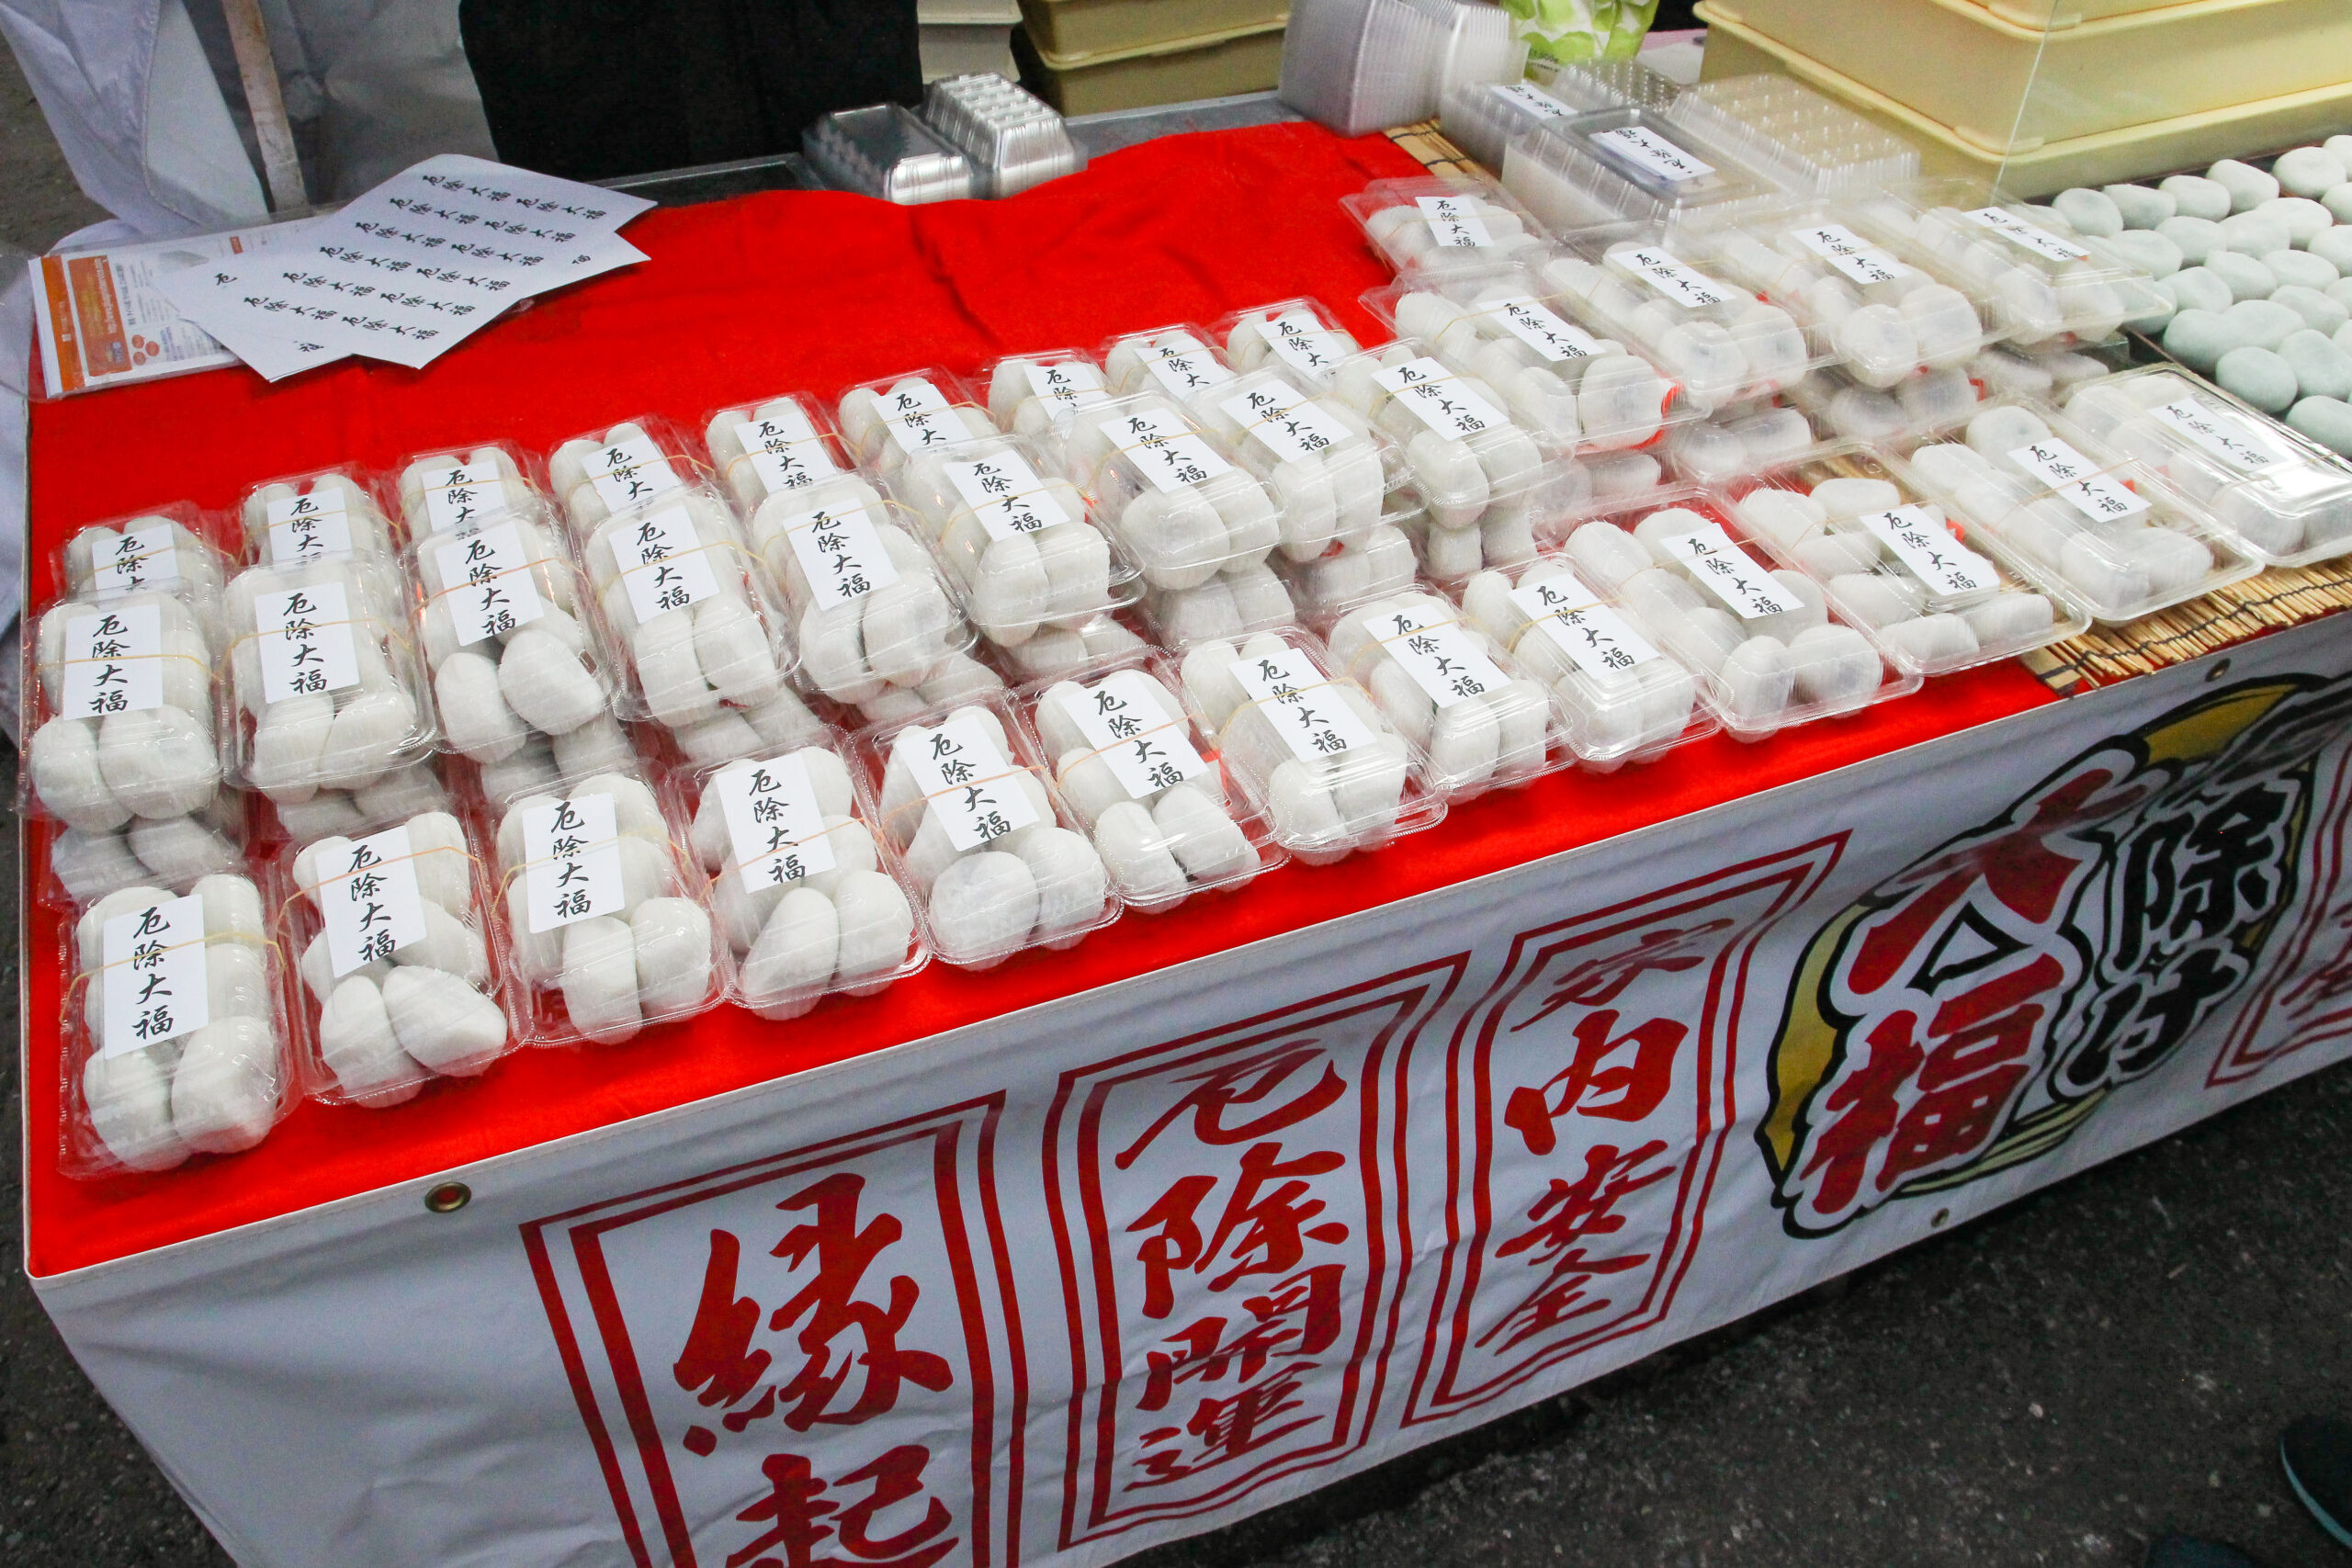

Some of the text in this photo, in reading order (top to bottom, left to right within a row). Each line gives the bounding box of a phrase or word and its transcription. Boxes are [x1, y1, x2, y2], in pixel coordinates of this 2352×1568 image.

[390, 197, 576, 243] 厄除大福 厄除大福
[423, 175, 607, 220] 厄除大福 厄除大福
[1436, 198, 1476, 248] 厄除大福
[320, 246, 511, 292] 厄除大福 厄除大福
[356, 221, 544, 267] 厄除大福 厄除大福
[1817, 230, 1894, 282] 厄除大福
[283, 272, 476, 316] 厄除大福 厄除大福
[1634, 253, 1721, 306] 厄除大福
[243, 297, 439, 341] 厄除大福 厄除大福
[1278, 321, 1336, 381] 厄除大
[1503, 302, 1589, 359] 厄除大福
[1046, 368, 1082, 418] 厄除
[1159, 346, 1211, 388] 厄除大
[1398, 367, 1486, 432] 厄除大福
[896, 392, 947, 446] 厄除大
[1127, 417, 1208, 484] 厄除大福
[1247, 391, 1330, 452] 厄除大福
[2166, 405, 2269, 464] 厄除大福
[606, 447, 653, 502] 厄除大
[974, 463, 1043, 532] 厄除大福
[2029, 445, 2128, 515] 厄除大福
[115, 536, 149, 592] 厄除大
[289, 498, 323, 565] 厄除大
[811, 512, 871, 598] 厄除大福
[1883, 513, 1977, 590] 厄除大福
[465, 538, 516, 637] 厄除大福
[637, 521, 690, 611] 厄除大福
[1689, 538, 1784, 615] 厄除大福
[282, 592, 328, 693] 厄除大福
[1394, 615, 1486, 698] 厄除大福
[1538, 585, 1635, 671] 厄除大福
[89, 617, 130, 713] 厄除大福
[1095, 690, 1185, 788] 厄除大福
[1261, 659, 1347, 752] 厄除大福
[929, 733, 1012, 842] 厄除大福
[549, 800, 594, 919] 厄除大福
[749, 769, 806, 884] 厄除大福
[350, 843, 397, 963] 厄除大福
[2070, 716, 2315, 1086] 除け
[132, 906, 174, 1040] 厄除大福
[1475, 918, 1735, 1356] 家内安全
[1114, 1039, 1349, 1492] 厄除開運
